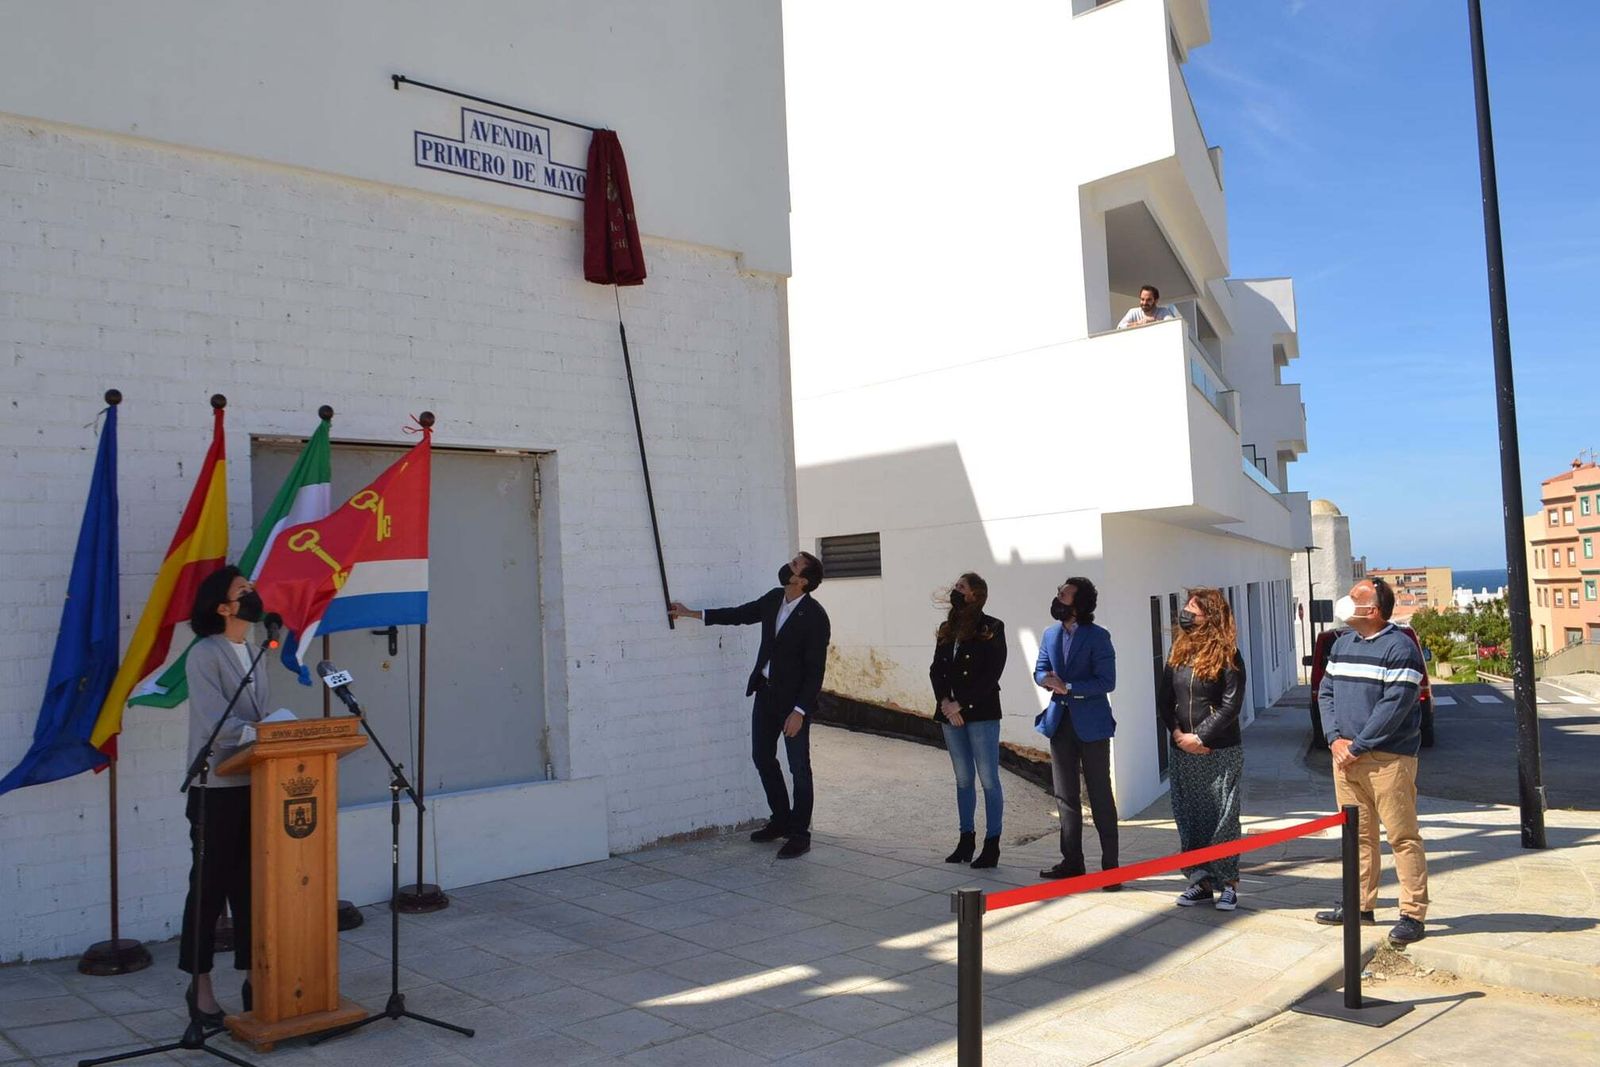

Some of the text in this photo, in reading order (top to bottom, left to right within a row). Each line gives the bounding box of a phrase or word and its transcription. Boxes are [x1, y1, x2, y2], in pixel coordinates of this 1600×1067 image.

[470, 119, 543, 155] AVENIDA
[421, 139, 586, 193] PRIMERO DE MAYO
